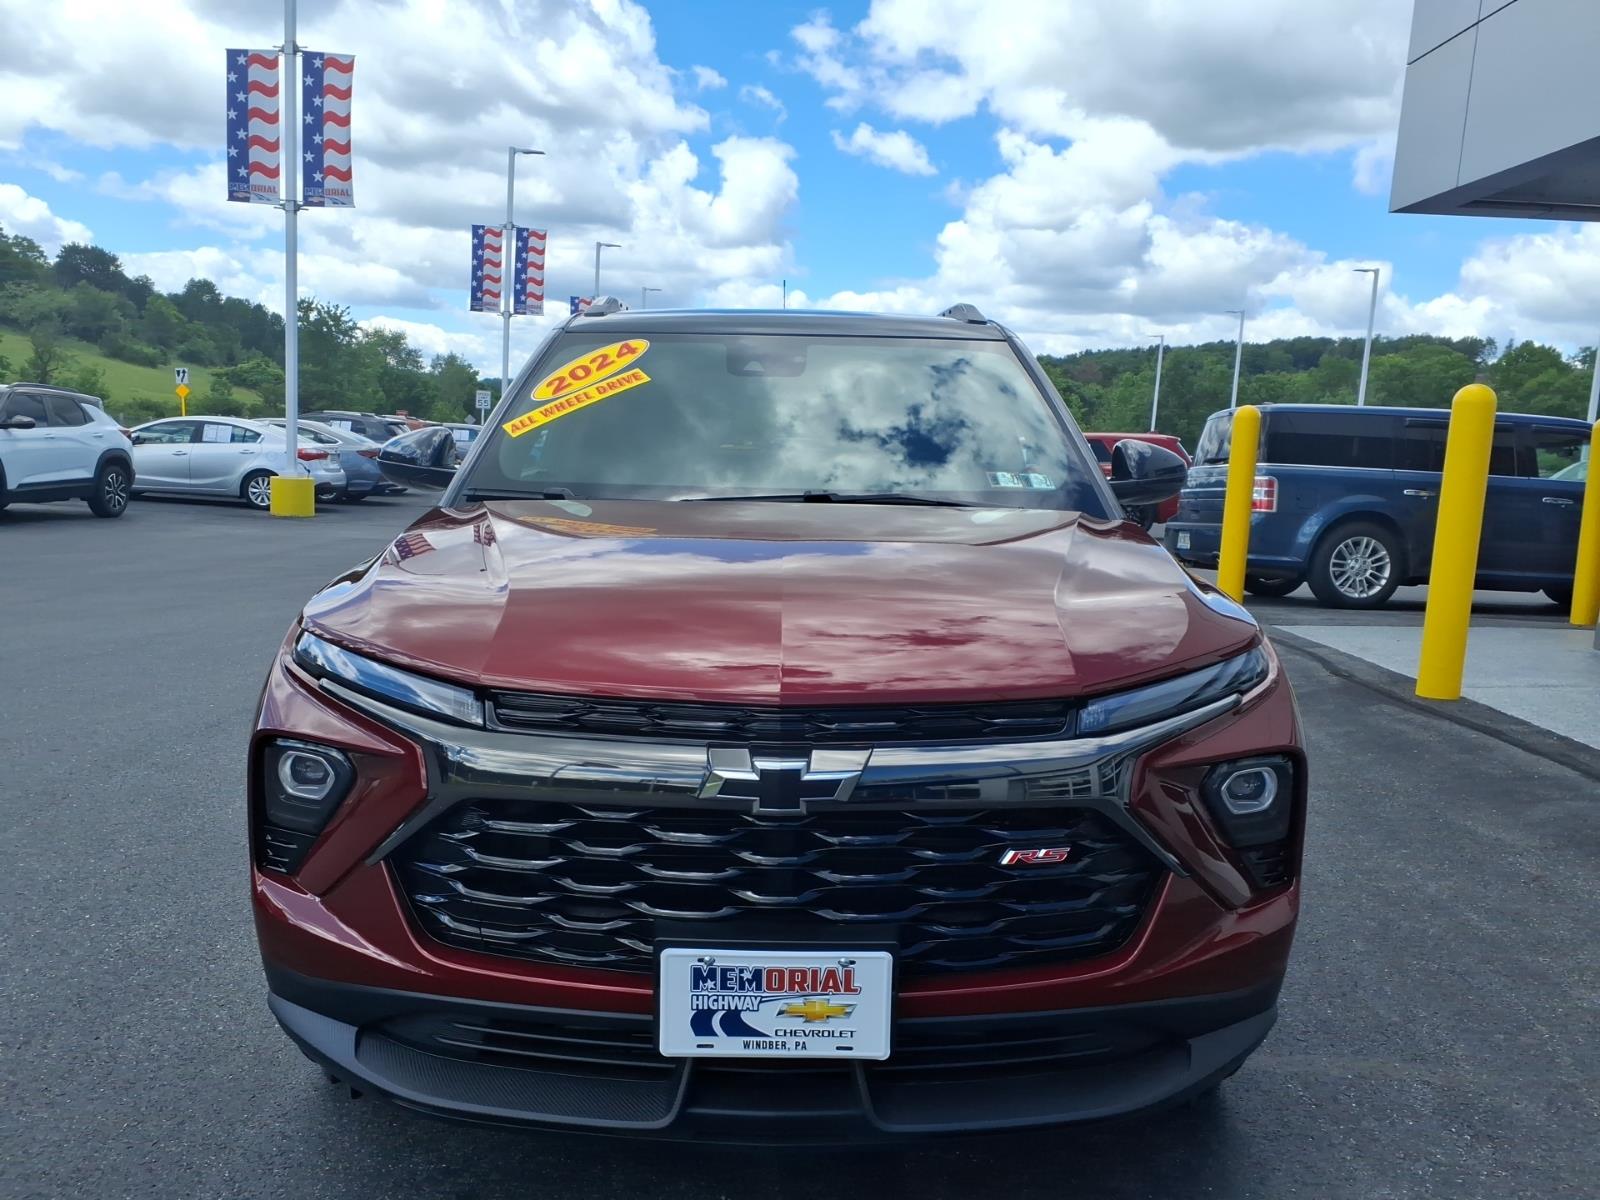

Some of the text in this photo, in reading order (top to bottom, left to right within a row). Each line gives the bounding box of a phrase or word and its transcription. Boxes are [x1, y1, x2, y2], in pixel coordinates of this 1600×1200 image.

[546, 342, 639, 396] 2024
[477, 399, 489, 407] 55
[510, 371, 645, 434] ALL WHEEL DRIVE
[1000, 847, 1071, 865] RS
[690, 965, 862, 995] MEMORIAL
[691, 995, 762, 1012] HIGHWAY
[774, 1028, 857, 1039] CHEVROLET
[742, 1039, 808, 1051] WINDBER, PA
